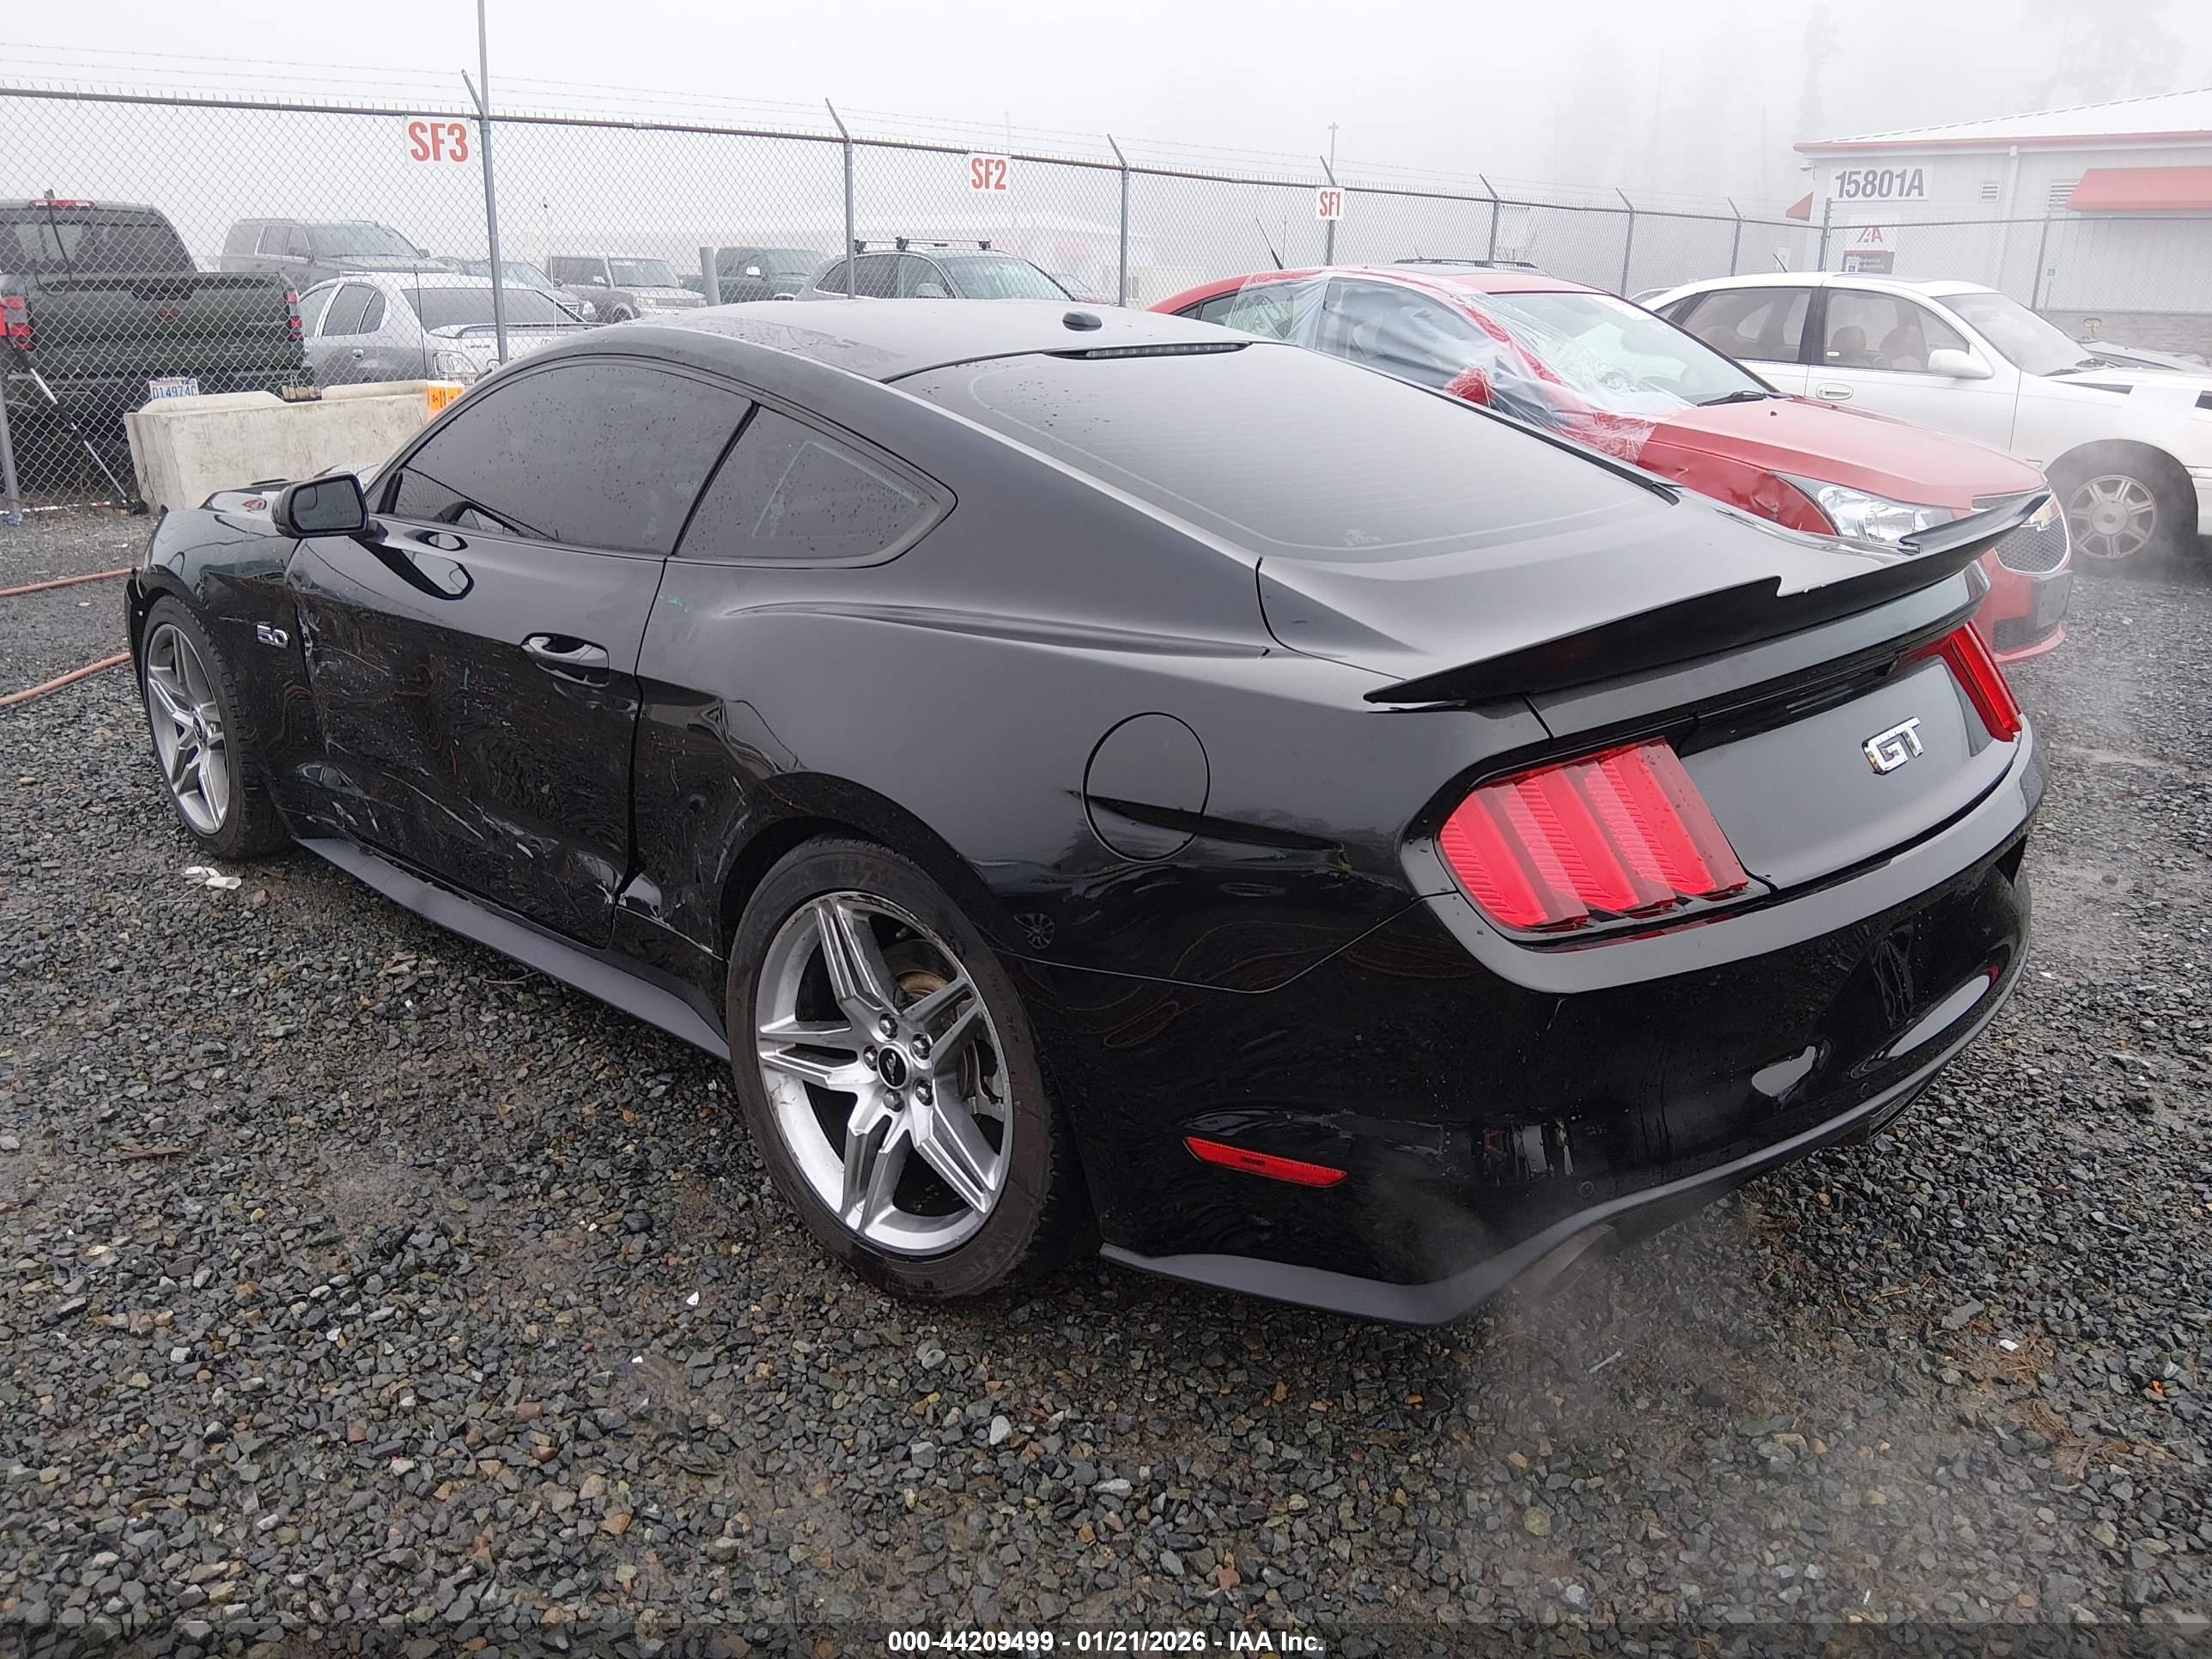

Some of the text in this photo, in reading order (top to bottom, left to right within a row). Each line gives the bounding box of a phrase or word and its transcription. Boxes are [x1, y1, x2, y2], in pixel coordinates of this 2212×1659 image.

[409, 121, 468, 162] SF3
[971, 158, 1006, 190] SF2
[1835, 169, 1923, 198] 15801A
[1319, 191, 1340, 216] SF1
[1862, 716, 1924, 775] GT
